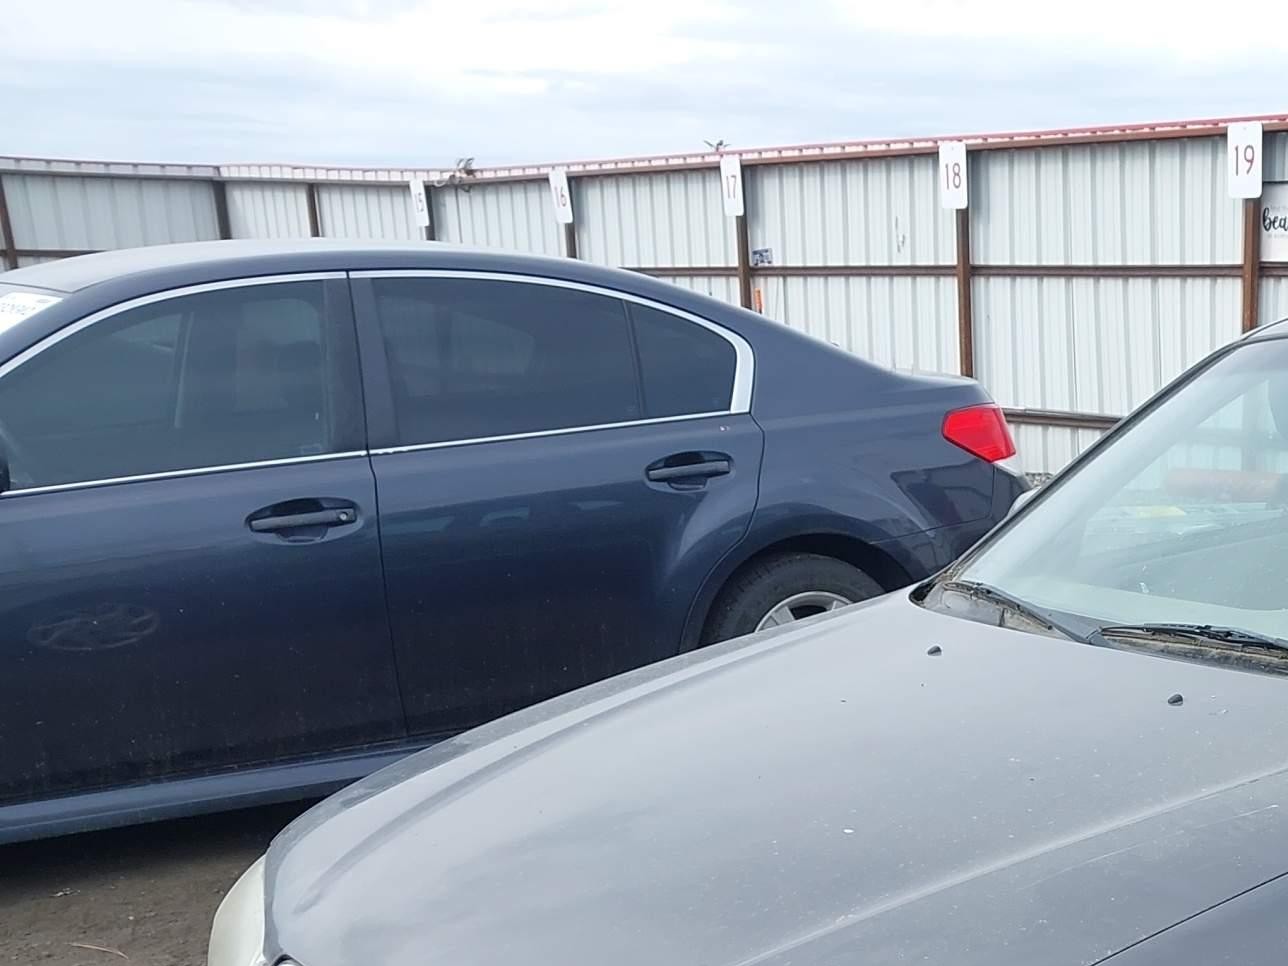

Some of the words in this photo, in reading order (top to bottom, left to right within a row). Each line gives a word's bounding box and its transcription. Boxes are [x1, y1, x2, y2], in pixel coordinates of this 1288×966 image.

[1235, 144, 1255, 176] 19
[726, 174, 737, 199] 17
[945, 162, 961, 190] 18
[554, 186, 567, 207] 16
